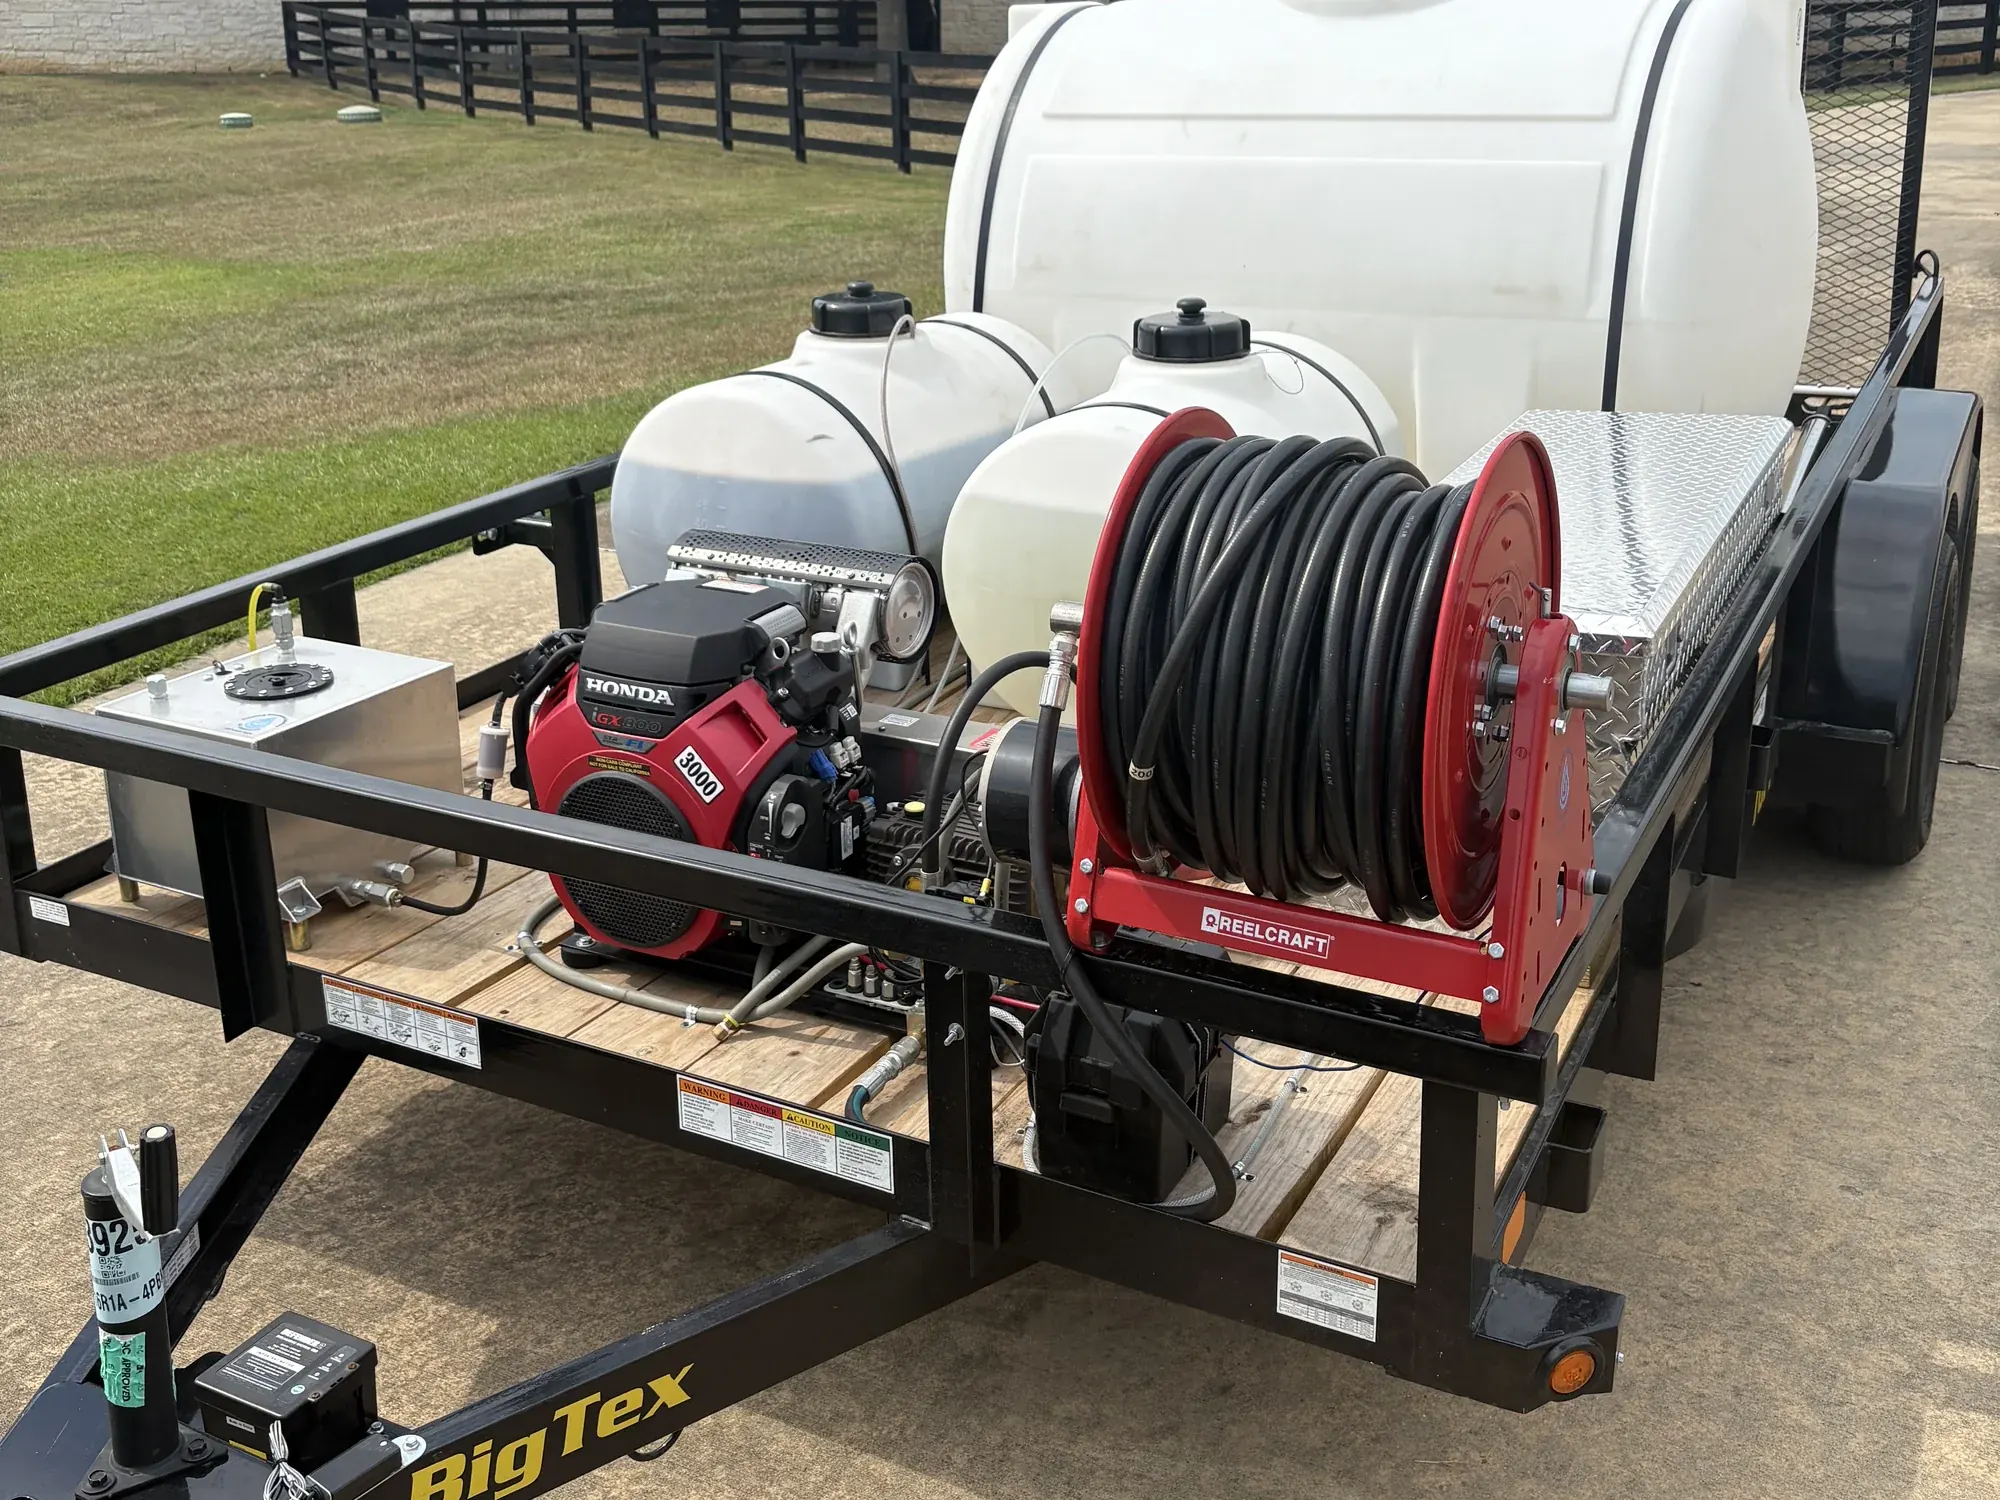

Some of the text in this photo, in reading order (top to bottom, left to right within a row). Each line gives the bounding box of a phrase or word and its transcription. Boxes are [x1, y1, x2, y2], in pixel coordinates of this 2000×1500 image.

[586, 677, 675, 706] HONDA
[679, 752, 718, 796] 3000
[1130, 768, 1153, 778] 200
[1219, 915, 1328, 953] REELCRAFT
[683, 1082, 726, 1101] WARNING
[743, 1102, 777, 1116] DANGER
[794, 1115, 831, 1132] CAUTION
[845, 1130, 880, 1146] NOTICE
[121, 1357, 131, 1402] APPROVED
